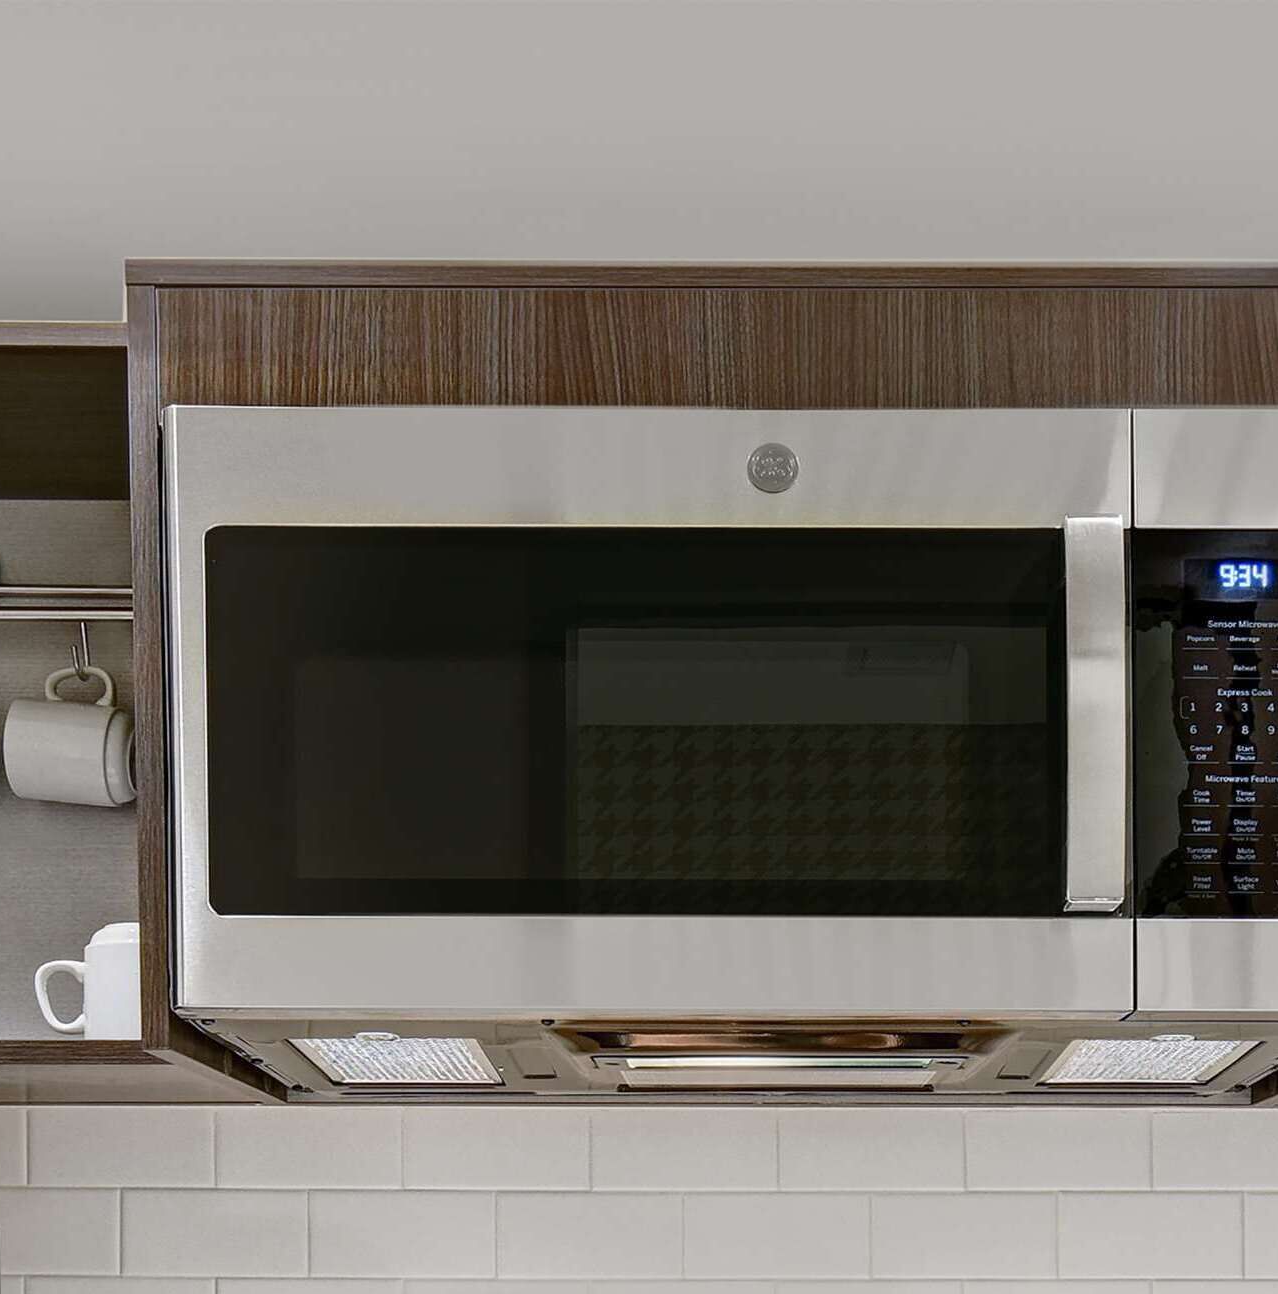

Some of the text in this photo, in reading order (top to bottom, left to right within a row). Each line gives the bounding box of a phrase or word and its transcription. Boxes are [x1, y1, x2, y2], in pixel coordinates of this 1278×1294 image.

[1219, 564, 1268, 588] 9:34
[1208, 620, 1237, 628] Sensor
[1187, 635, 1214, 643] Popcorn
[1229, 635, 1260, 643] Beverage
[1217, 688, 1273, 698] Express Cook
[1190, 702, 1196, 712] 1
[1215, 702, 1223, 712] 2
[1241, 703, 1249, 712] 3
[1267, 703, 1275, 712] 4
[1189, 725, 1198, 735] 6
[1216, 725, 1223, 735] 7
[1241, 725, 1249, 735] 8
[1267, 725, 1276, 735] 9
[1189, 744, 1214, 752] Cancel
[1236, 744, 1255, 752] Start
[1205, 775, 1249, 783] Microwave
[1186, 846, 1218, 854] Turntable
[1233, 875, 1260, 883] Surface
[1237, 883, 1255, 891] Light
